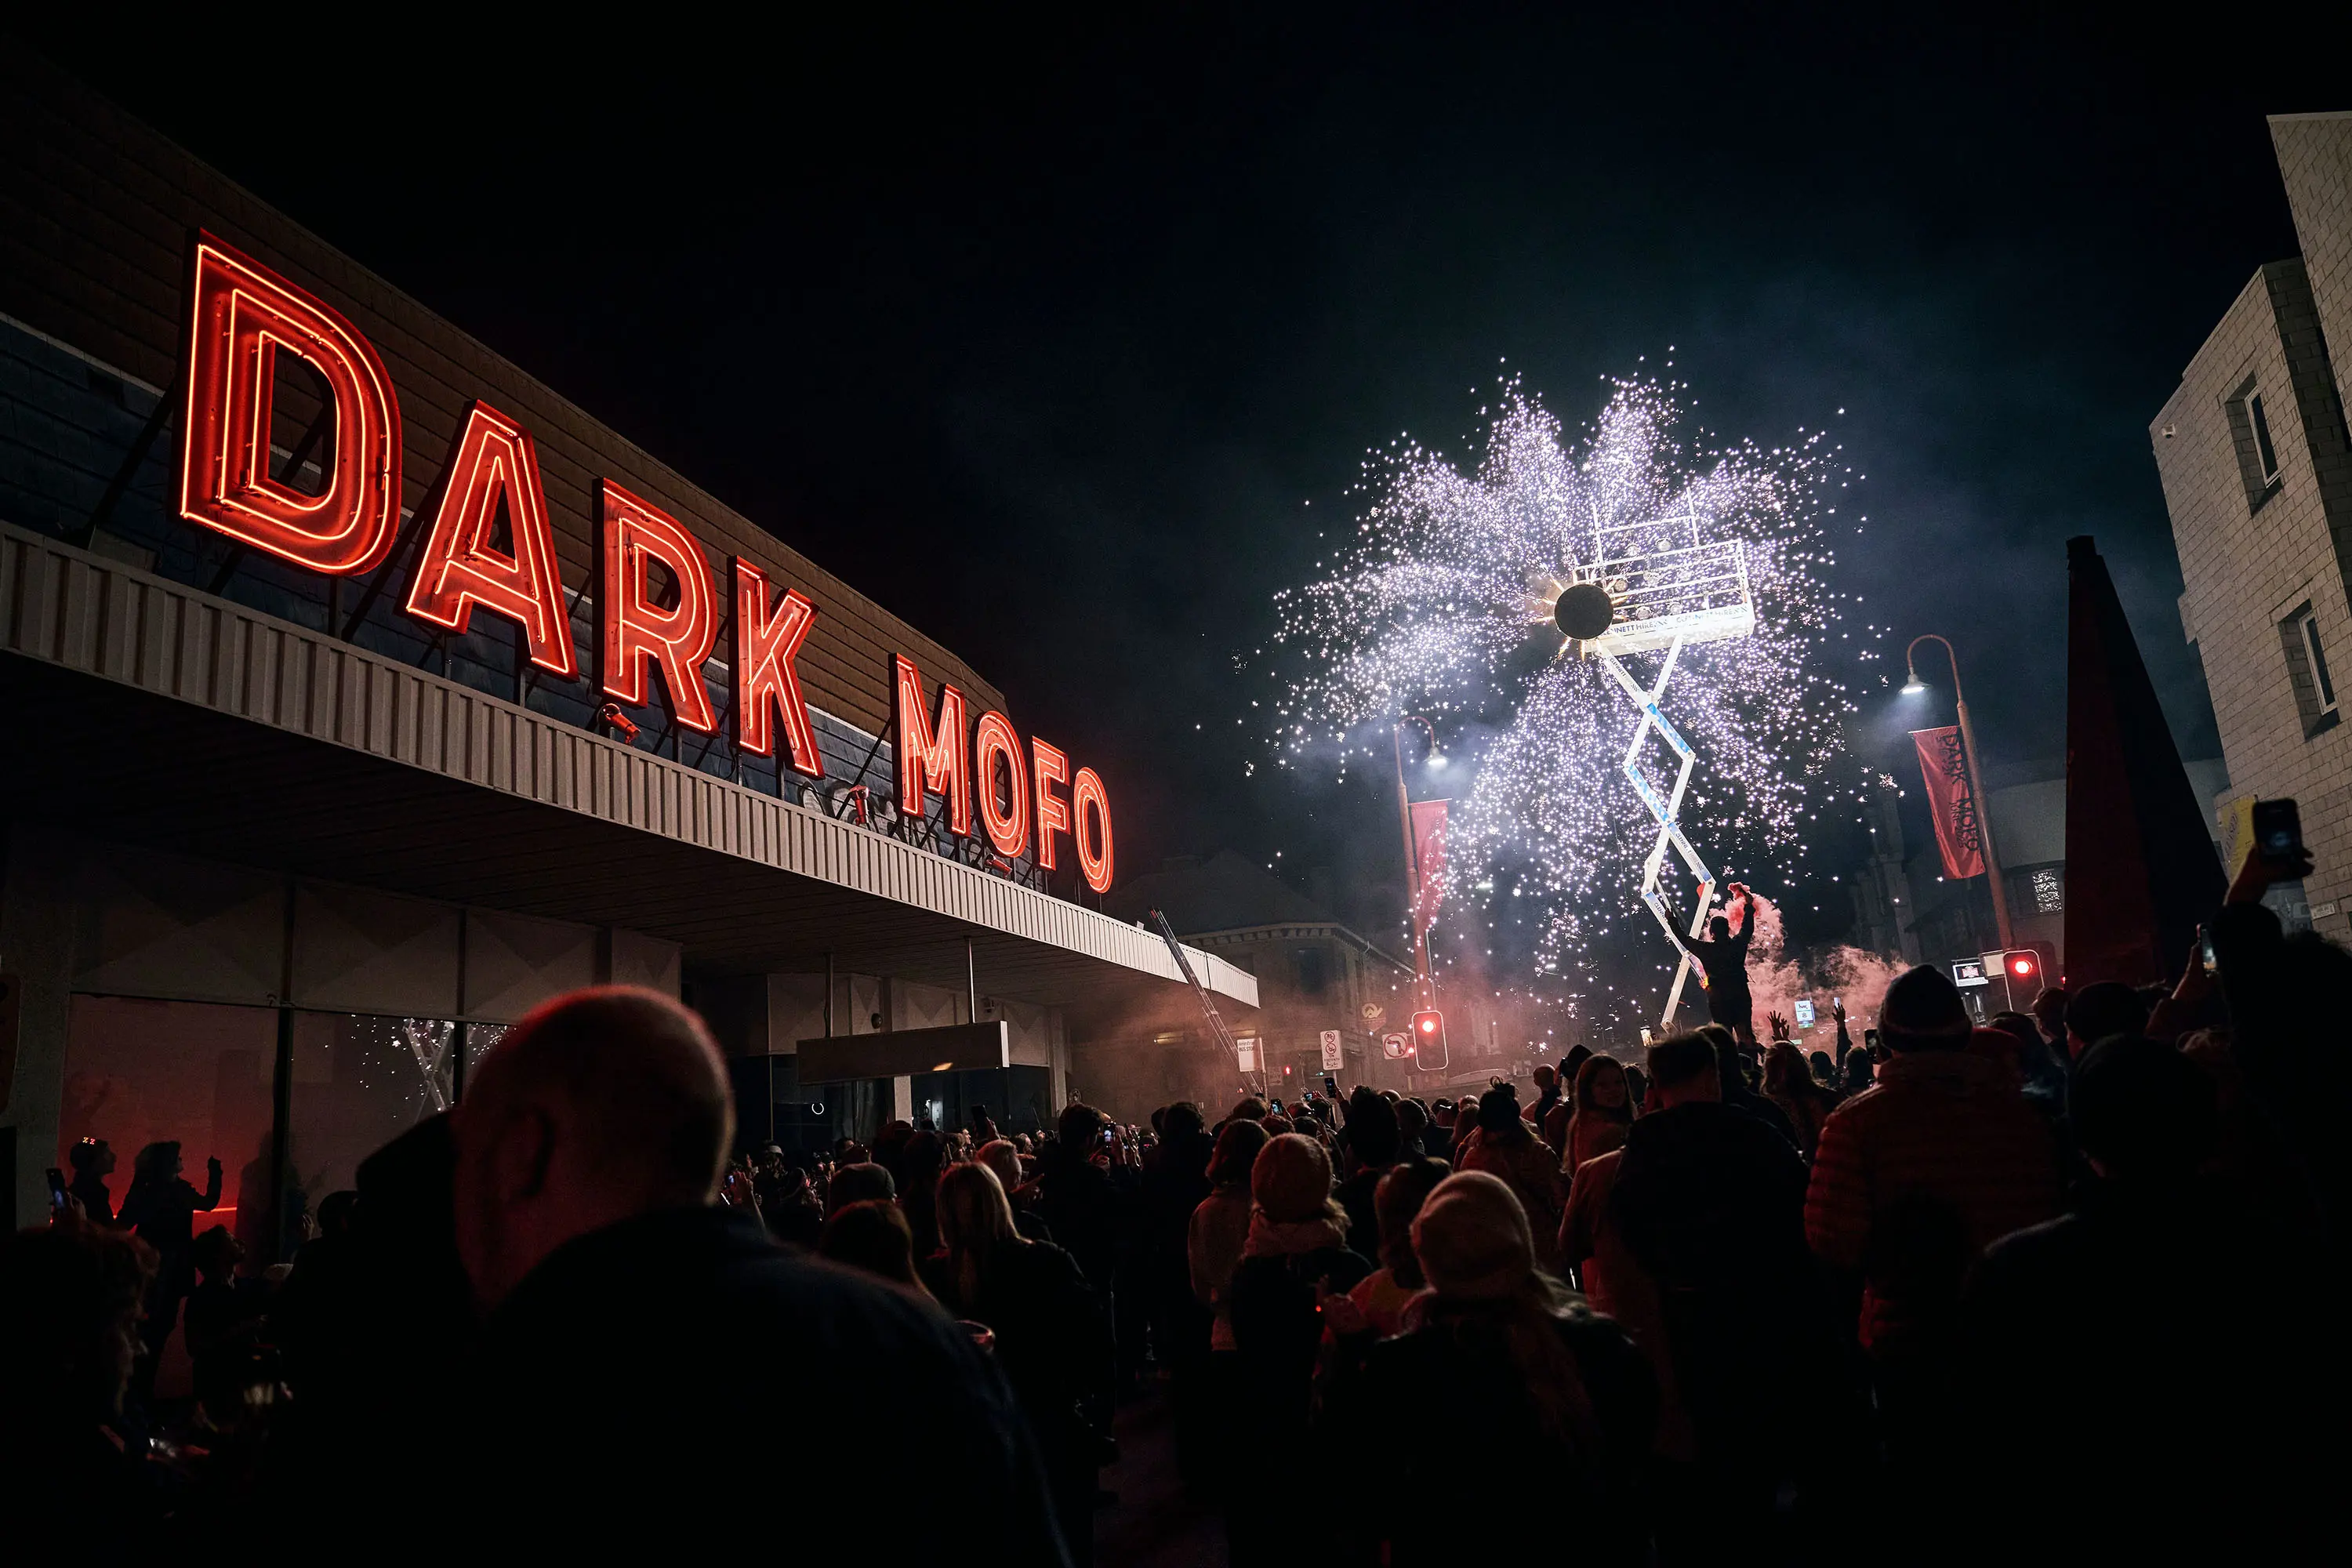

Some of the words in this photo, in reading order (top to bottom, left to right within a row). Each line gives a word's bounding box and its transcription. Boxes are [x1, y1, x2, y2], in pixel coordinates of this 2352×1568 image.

[180, 227, 825, 779] DARK
[889, 652, 1113, 894] MOFO
[1943, 735, 1966, 785] DARK
